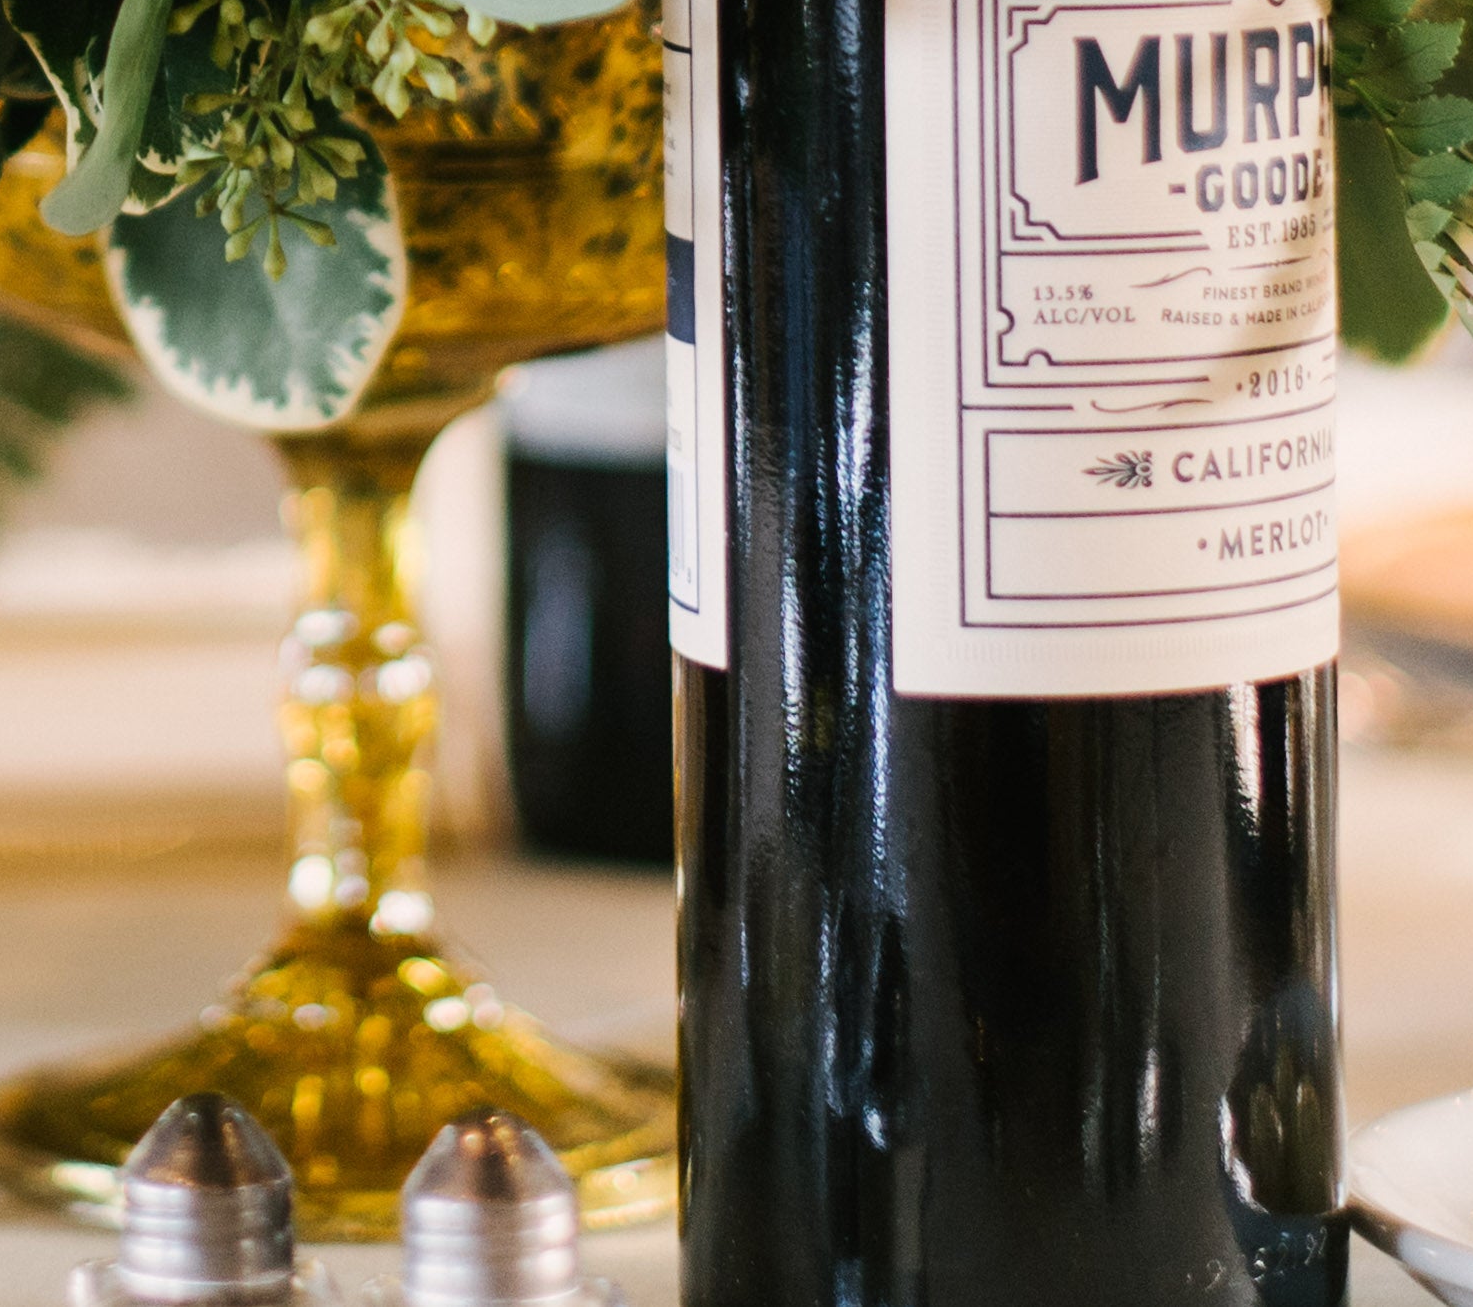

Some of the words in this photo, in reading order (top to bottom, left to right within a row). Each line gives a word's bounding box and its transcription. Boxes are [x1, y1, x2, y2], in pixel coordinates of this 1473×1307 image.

[1033, 284, 1094, 301] 13.5%
[1202, 286, 1258, 301] FINEST
[1263, 279, 1302, 298] BRAND
[1033, 306, 1137, 325] ALC/VOL
[1161, 308, 1223, 326] RAISED
[1229, 313, 1240, 326] &
[1246, 308, 1283, 325] MADE
[1286, 306, 1298, 320] IN
[1171, 428, 1333, 483] CALIFORNIA
